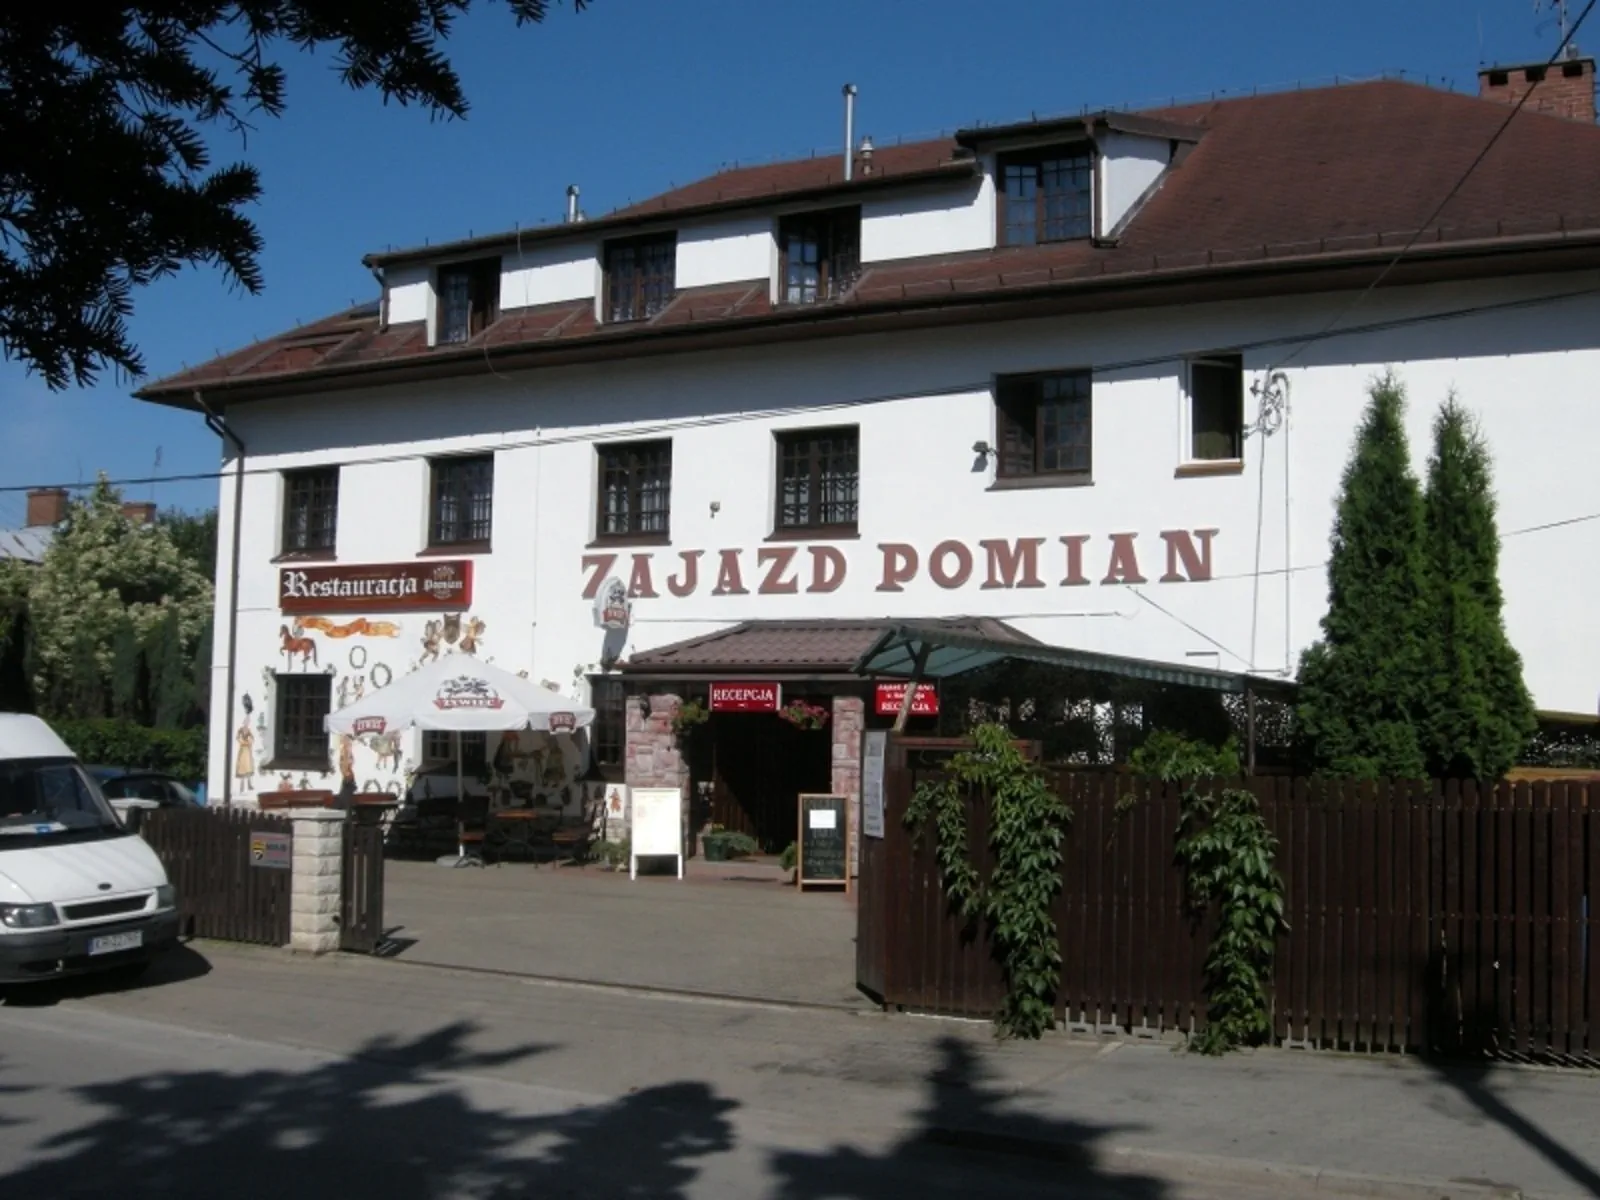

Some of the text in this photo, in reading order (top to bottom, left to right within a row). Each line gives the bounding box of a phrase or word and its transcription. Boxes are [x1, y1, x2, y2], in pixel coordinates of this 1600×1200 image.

[582, 528, 1220, 599] ZAJAZD POMIAN
[283, 571, 417, 598] Restauracja
[713, 687, 774, 701] RECEPCJA
[881, 702, 930, 711] RECCJA
